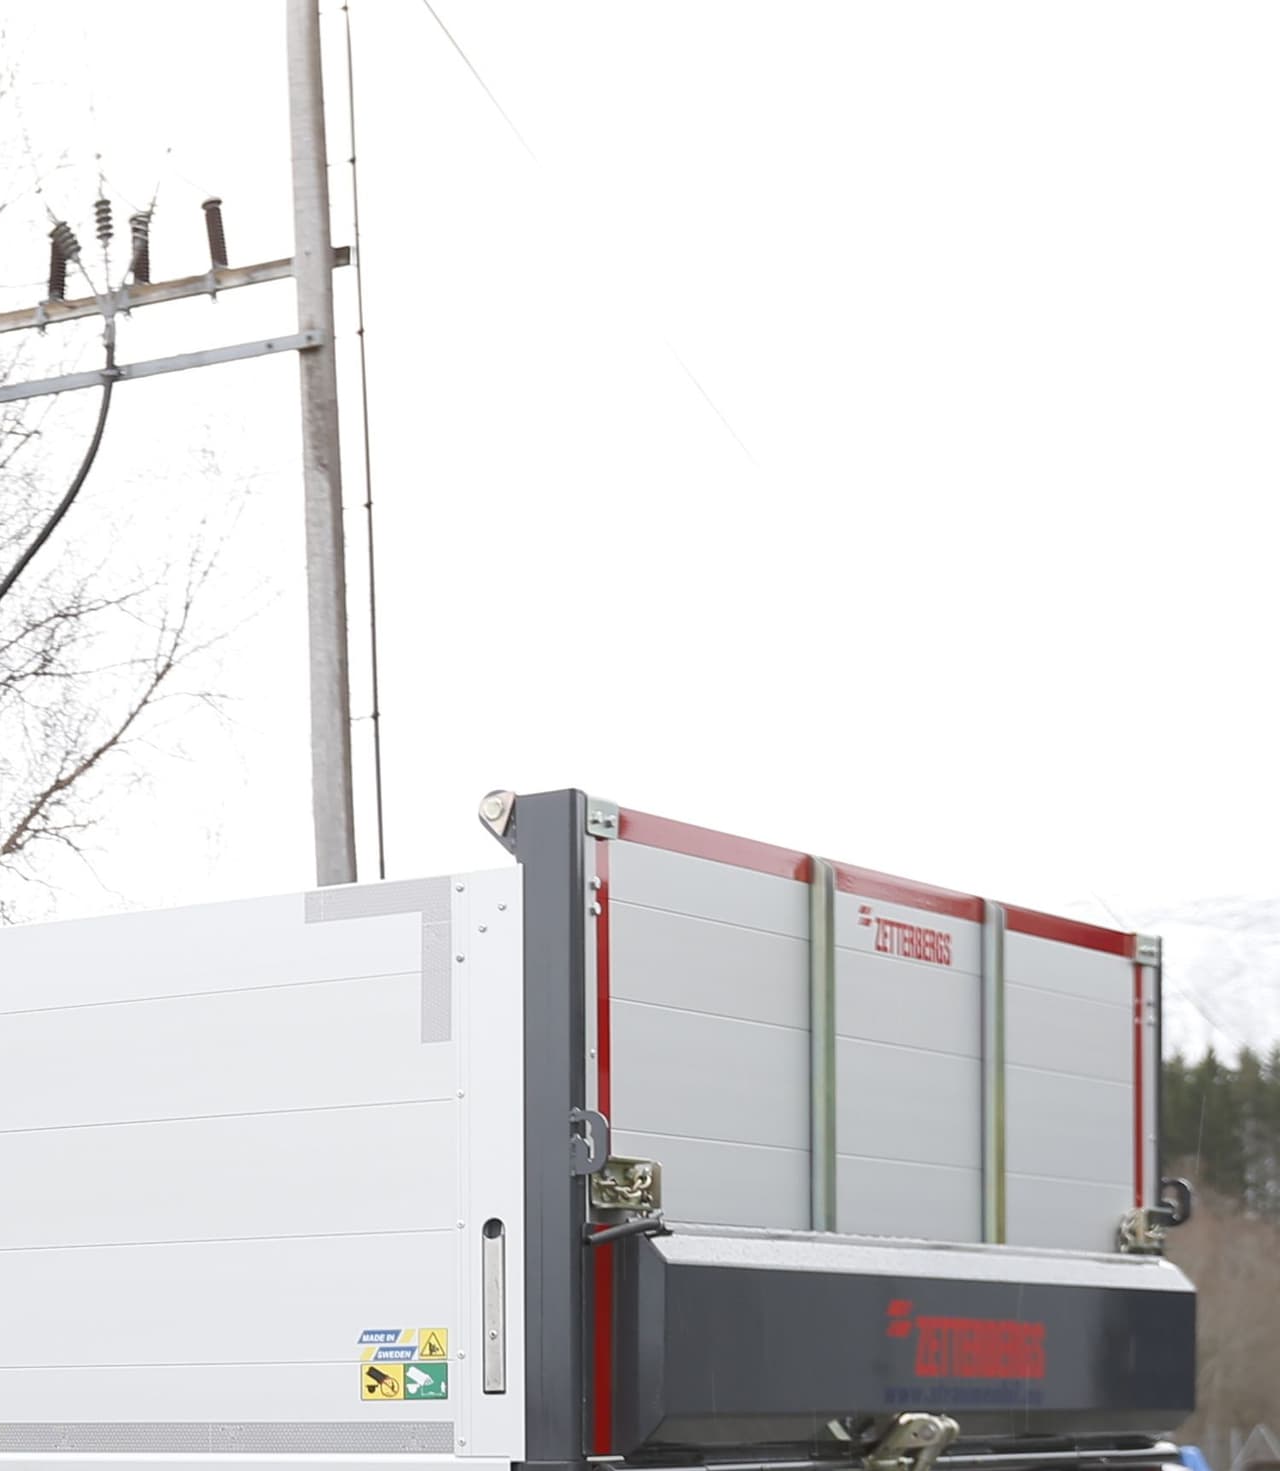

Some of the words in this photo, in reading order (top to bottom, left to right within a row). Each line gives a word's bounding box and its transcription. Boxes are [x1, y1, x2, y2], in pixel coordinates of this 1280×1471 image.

[875, 917, 952, 966] ZETTERBERGS
[361, 1333, 385, 1343] MADE
[386, 1333, 395, 1342] IN
[915, 1317, 1046, 1377] ZETTERBERGS
[377, 1349, 412, 1360] SWEDEN
